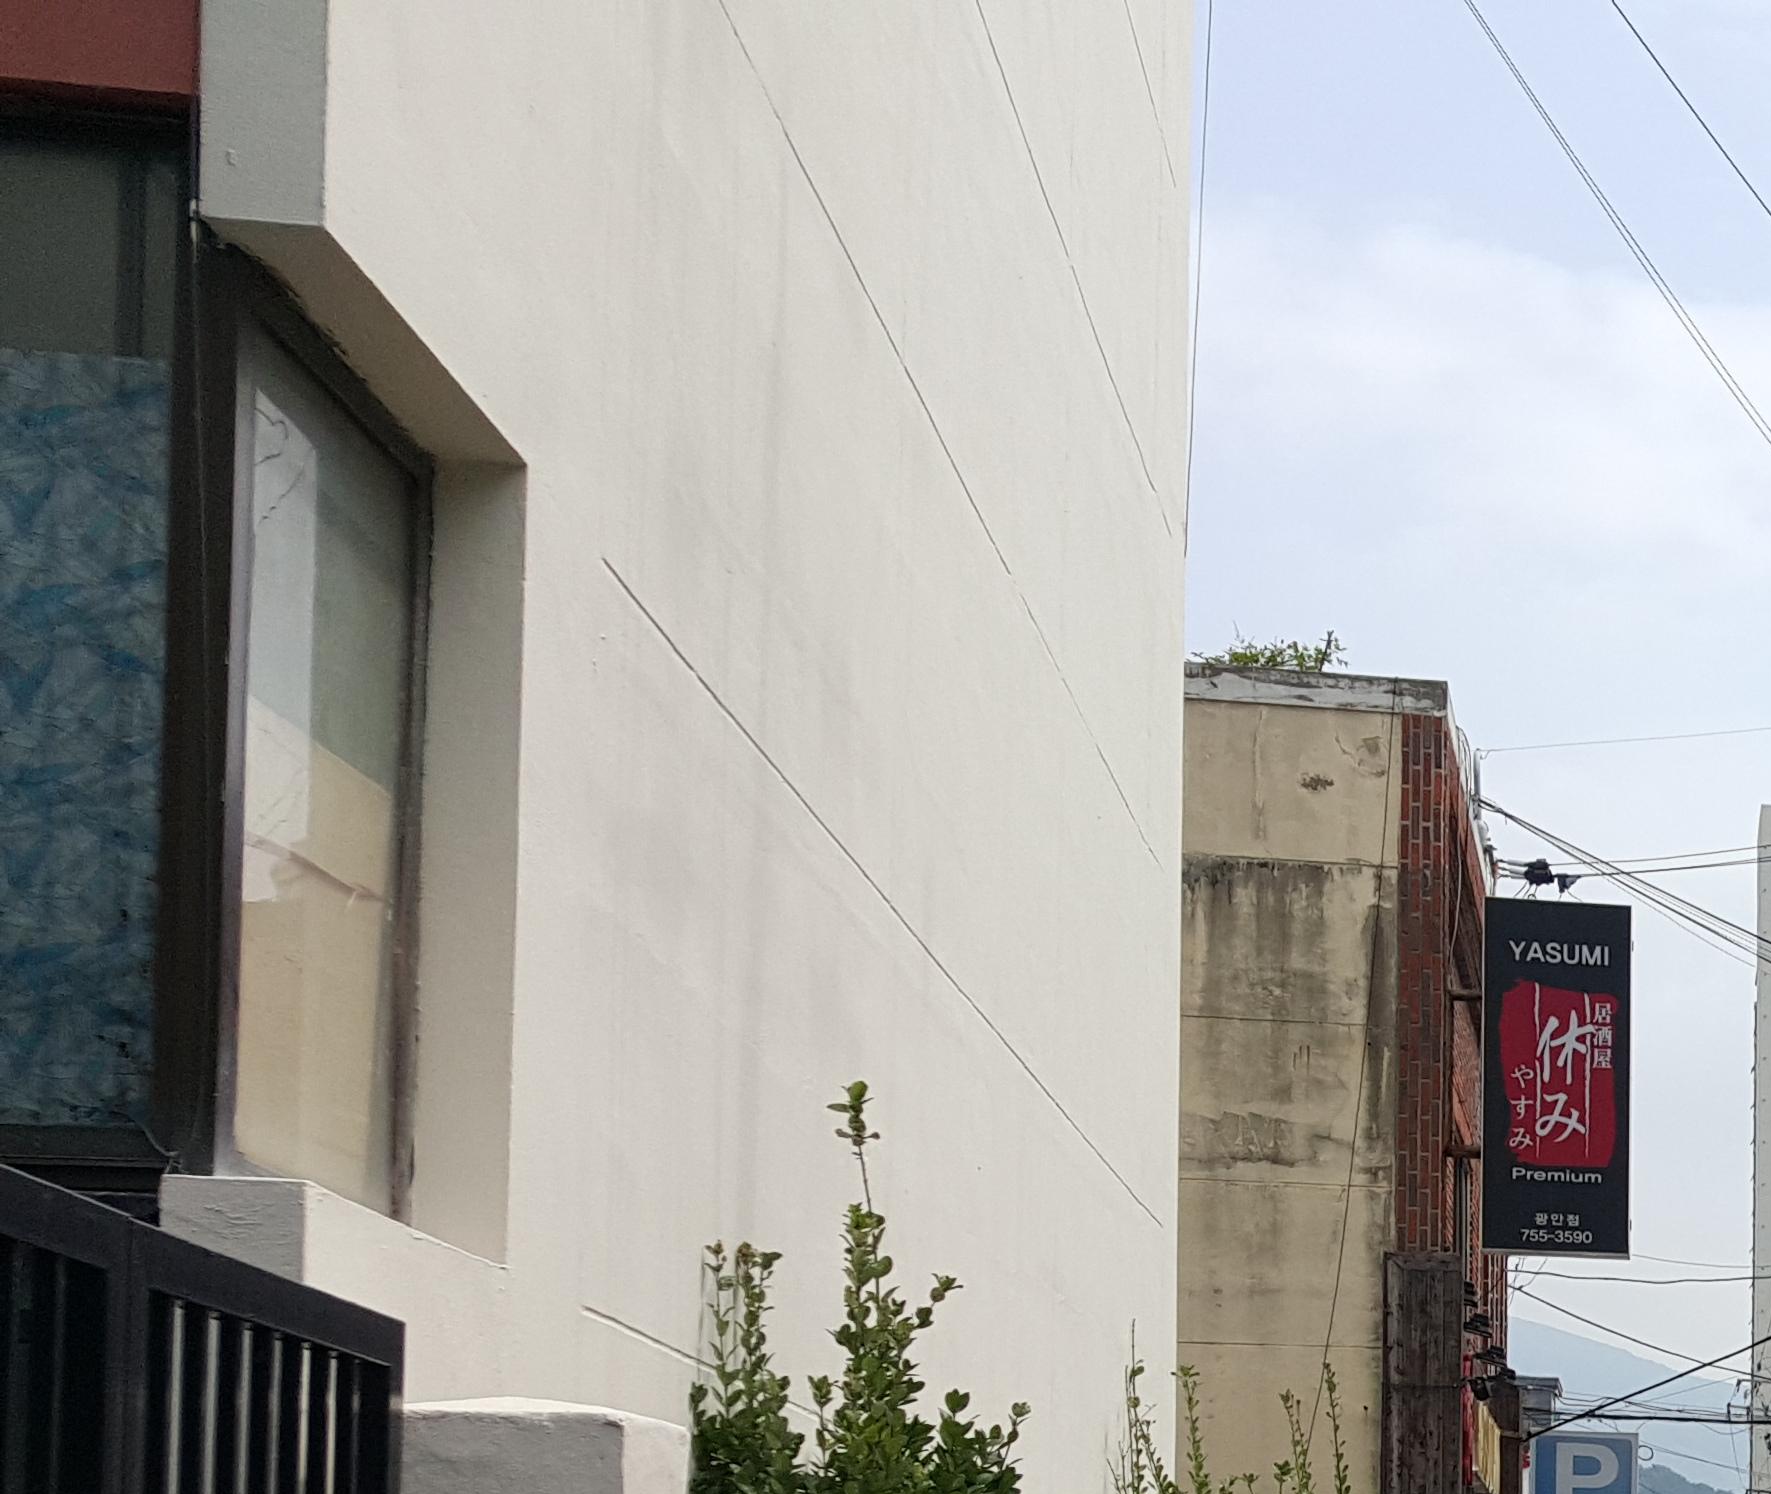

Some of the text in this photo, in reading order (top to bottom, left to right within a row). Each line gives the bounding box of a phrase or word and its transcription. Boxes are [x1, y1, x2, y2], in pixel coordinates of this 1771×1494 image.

[1508, 940, 1609, 966] YASUMI
[1592, 1003, 1613, 1069] 居酒屋
[1535, 1009, 1597, 1143] 休み
[1508, 1064, 1534, 1150] やすみ
[1511, 1166, 1603, 1184] Premium
[1534, 1212, 1581, 1227] 광안점
[1520, 1228, 1593, 1245] 755-3590
